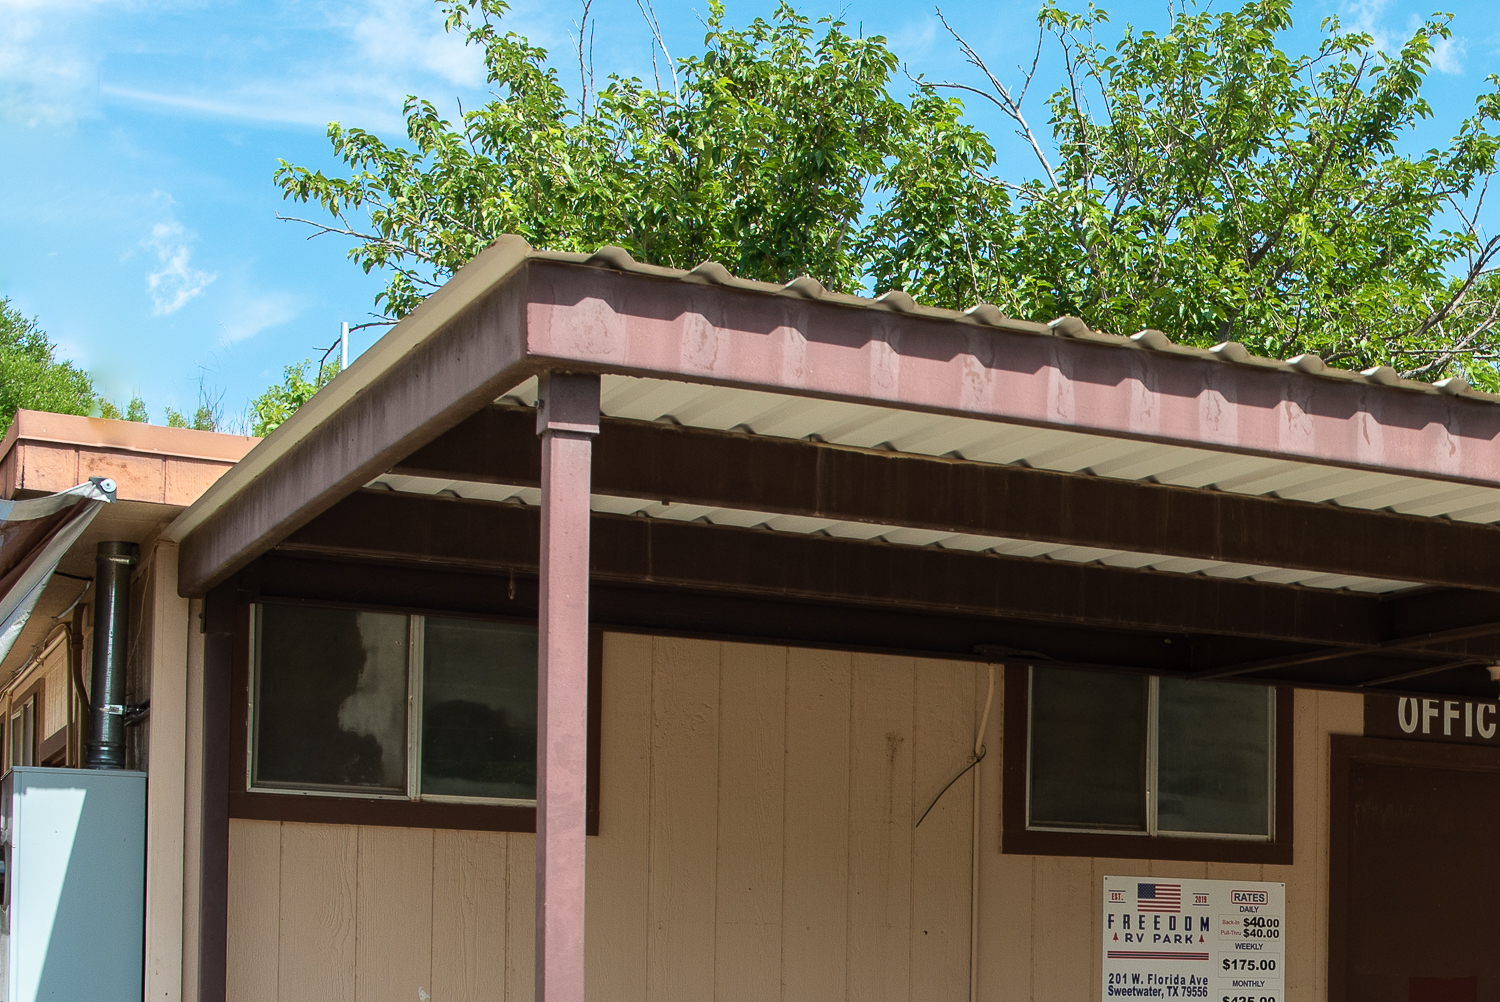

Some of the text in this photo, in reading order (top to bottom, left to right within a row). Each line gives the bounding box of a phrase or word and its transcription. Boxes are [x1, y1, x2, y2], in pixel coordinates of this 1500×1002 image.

[1111, 892, 1208, 904] EST. 2019
[1234, 892, 1265, 903] RATES
[1107, 914, 1210, 932] FREEDOM
[1243, 916, 1280, 928] $40.00
[1124, 933, 1193, 944] RV PARK
[1243, 928, 1280, 938] $40.00
[1234, 942, 1264, 950] WEEKLY
[1222, 958, 1276, 971] $175.00
[1108, 973, 1209, 986] 201 W. Florida Ave
[1232, 980, 1265, 988] MONTHLY
[1107, 985, 1208, 999] Sweetwater, TX 79556
